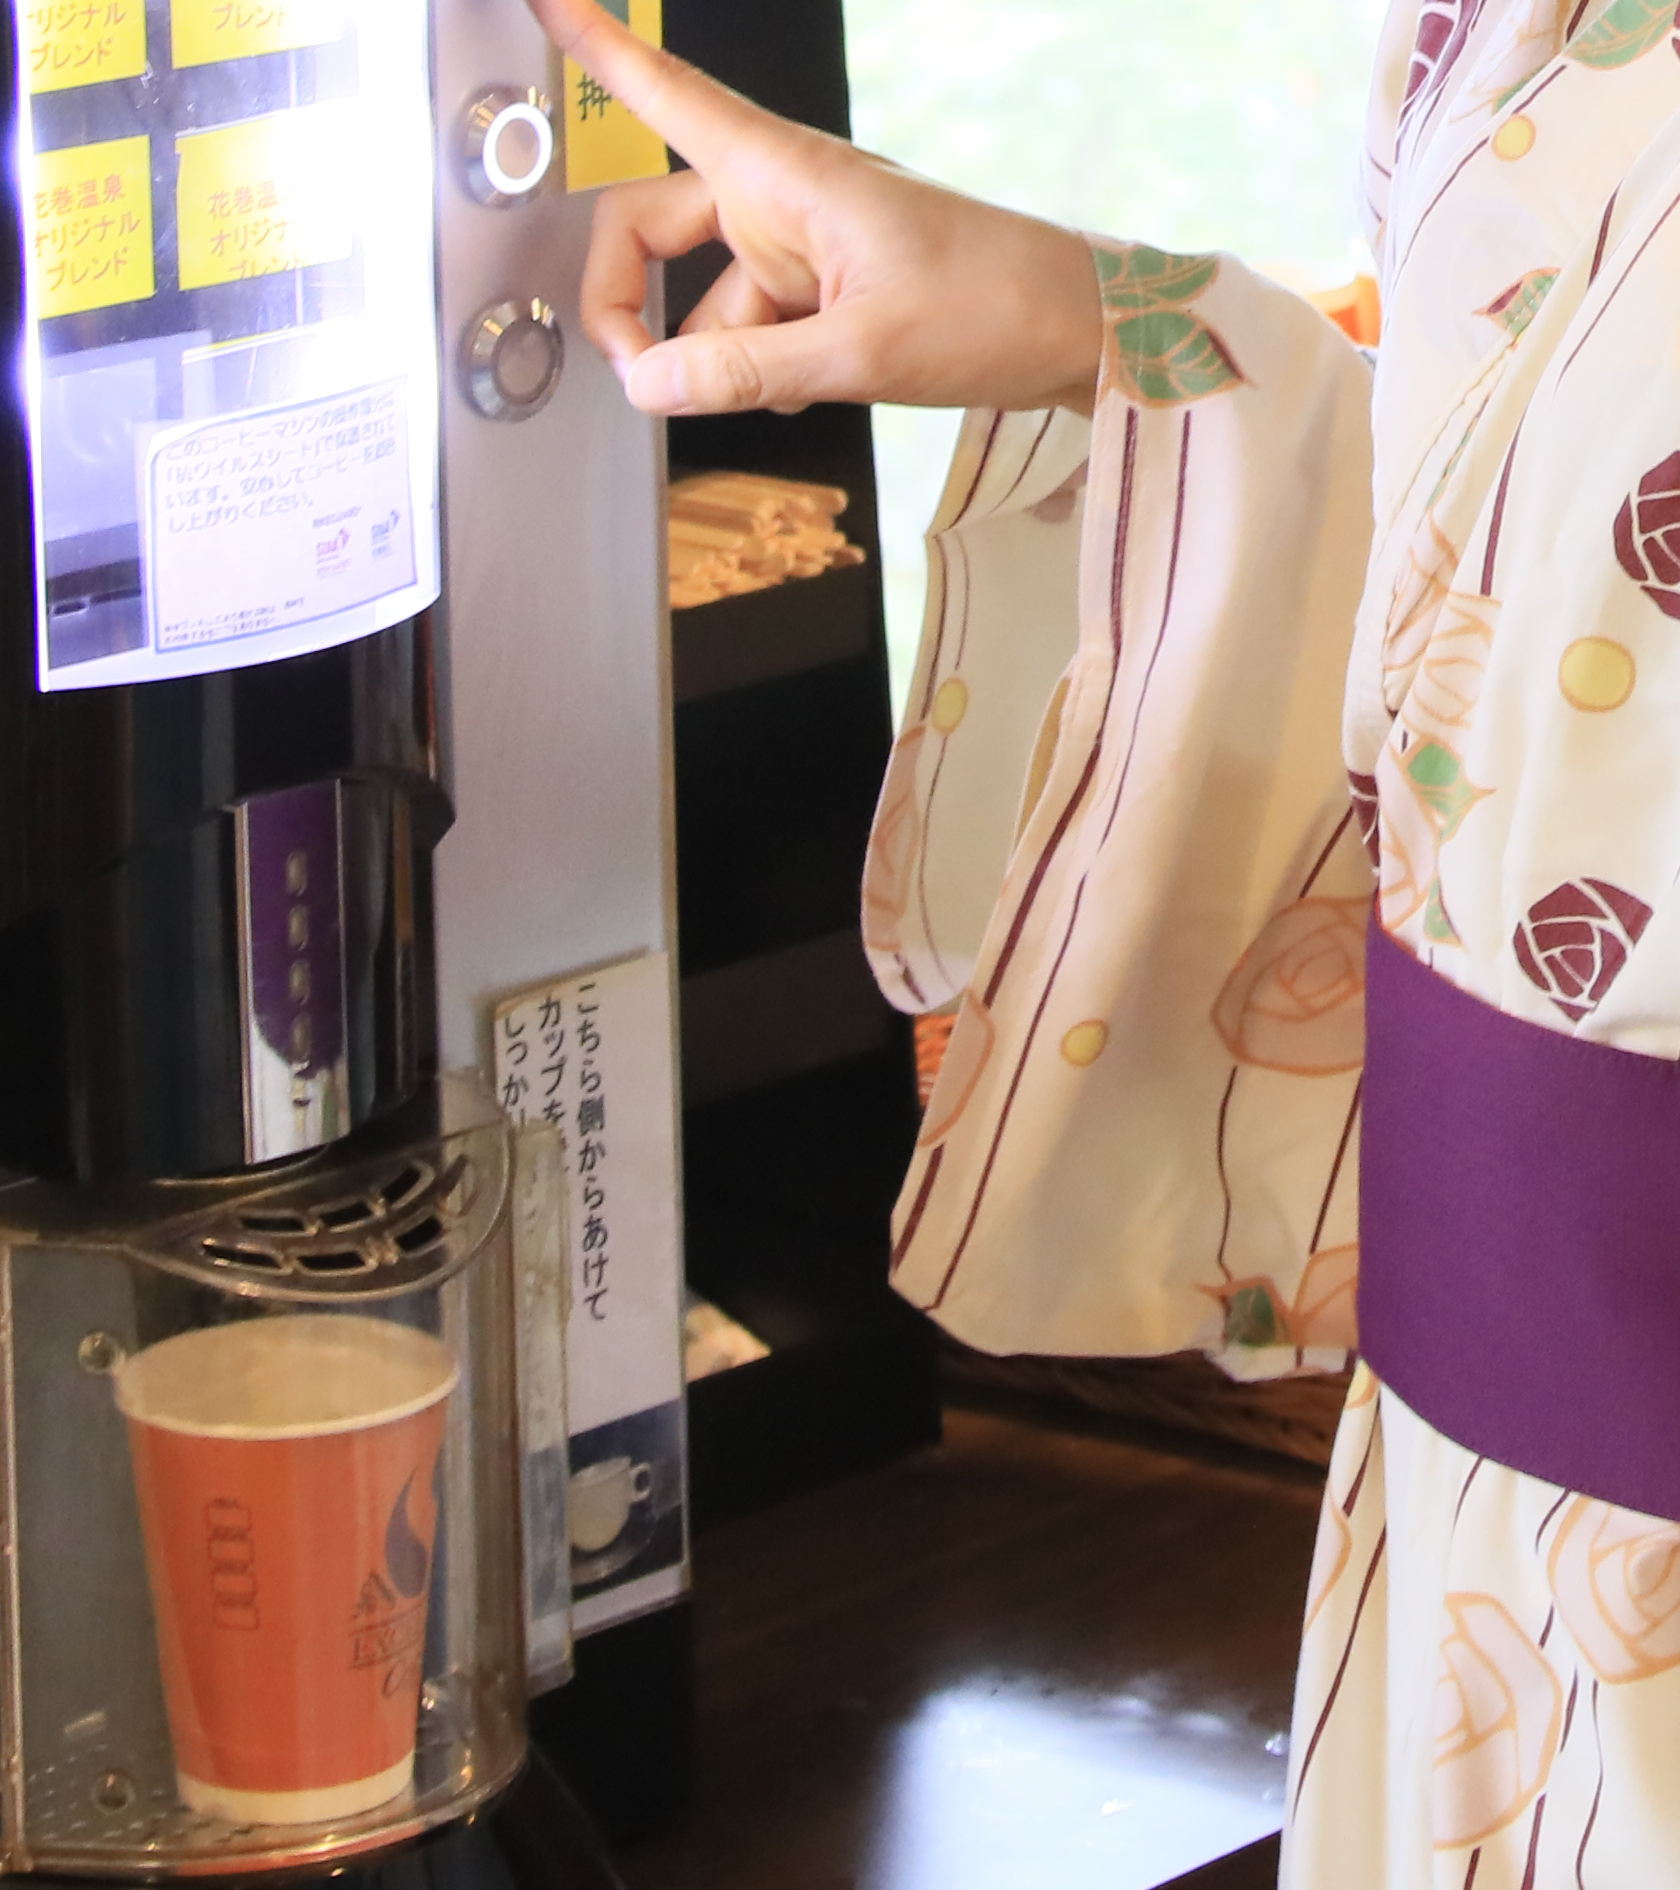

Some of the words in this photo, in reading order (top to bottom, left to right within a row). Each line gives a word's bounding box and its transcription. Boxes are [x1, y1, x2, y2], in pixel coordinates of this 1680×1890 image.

[26, 2, 127, 34] リジナル
[31, 36, 113, 72] ブレンド
[577, 72, 612, 121] 押
[46, 245, 129, 292] ブレンド
[576, 983, 607, 1322] こちら側からあけて
